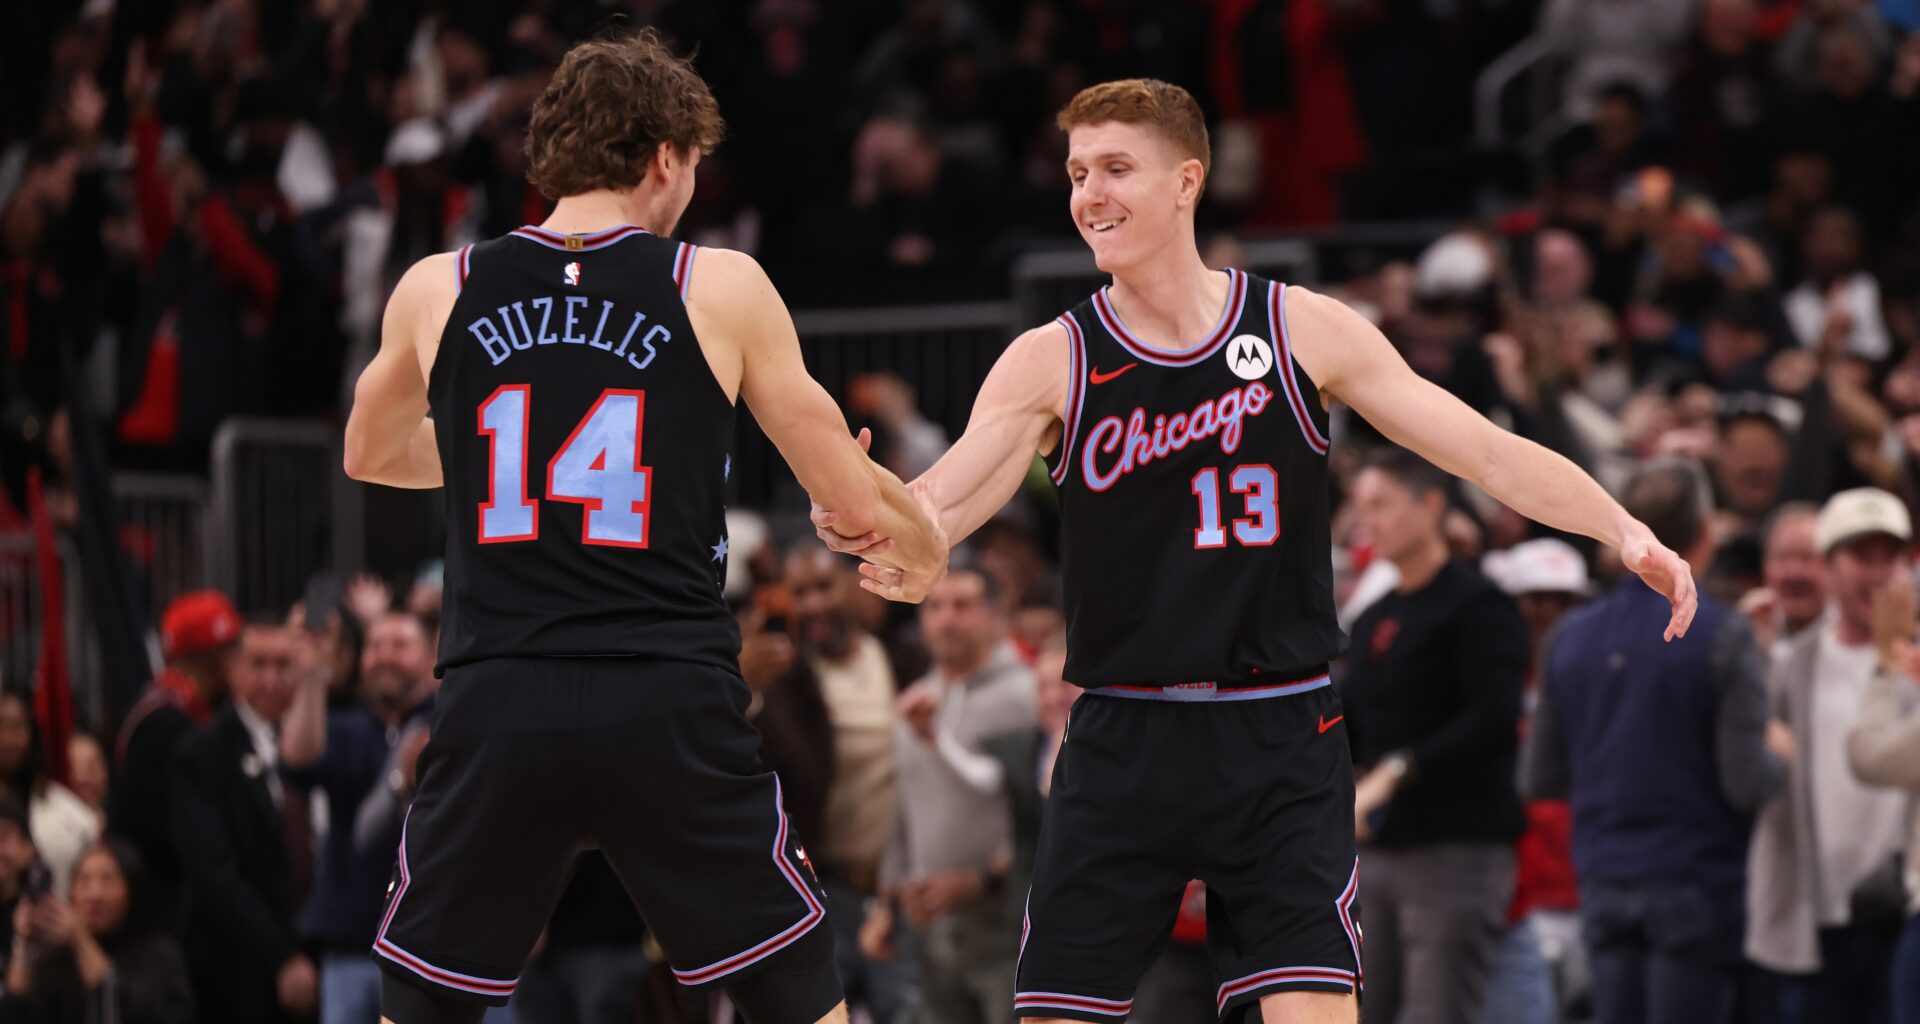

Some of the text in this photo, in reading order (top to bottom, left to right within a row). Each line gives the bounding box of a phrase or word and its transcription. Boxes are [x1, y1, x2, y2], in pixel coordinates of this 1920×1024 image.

[467, 296, 671, 370] BUZELIS
[477, 383, 653, 549] 14
[1081, 381, 1274, 492] Chicago
[1191, 463, 1281, 549] 13
